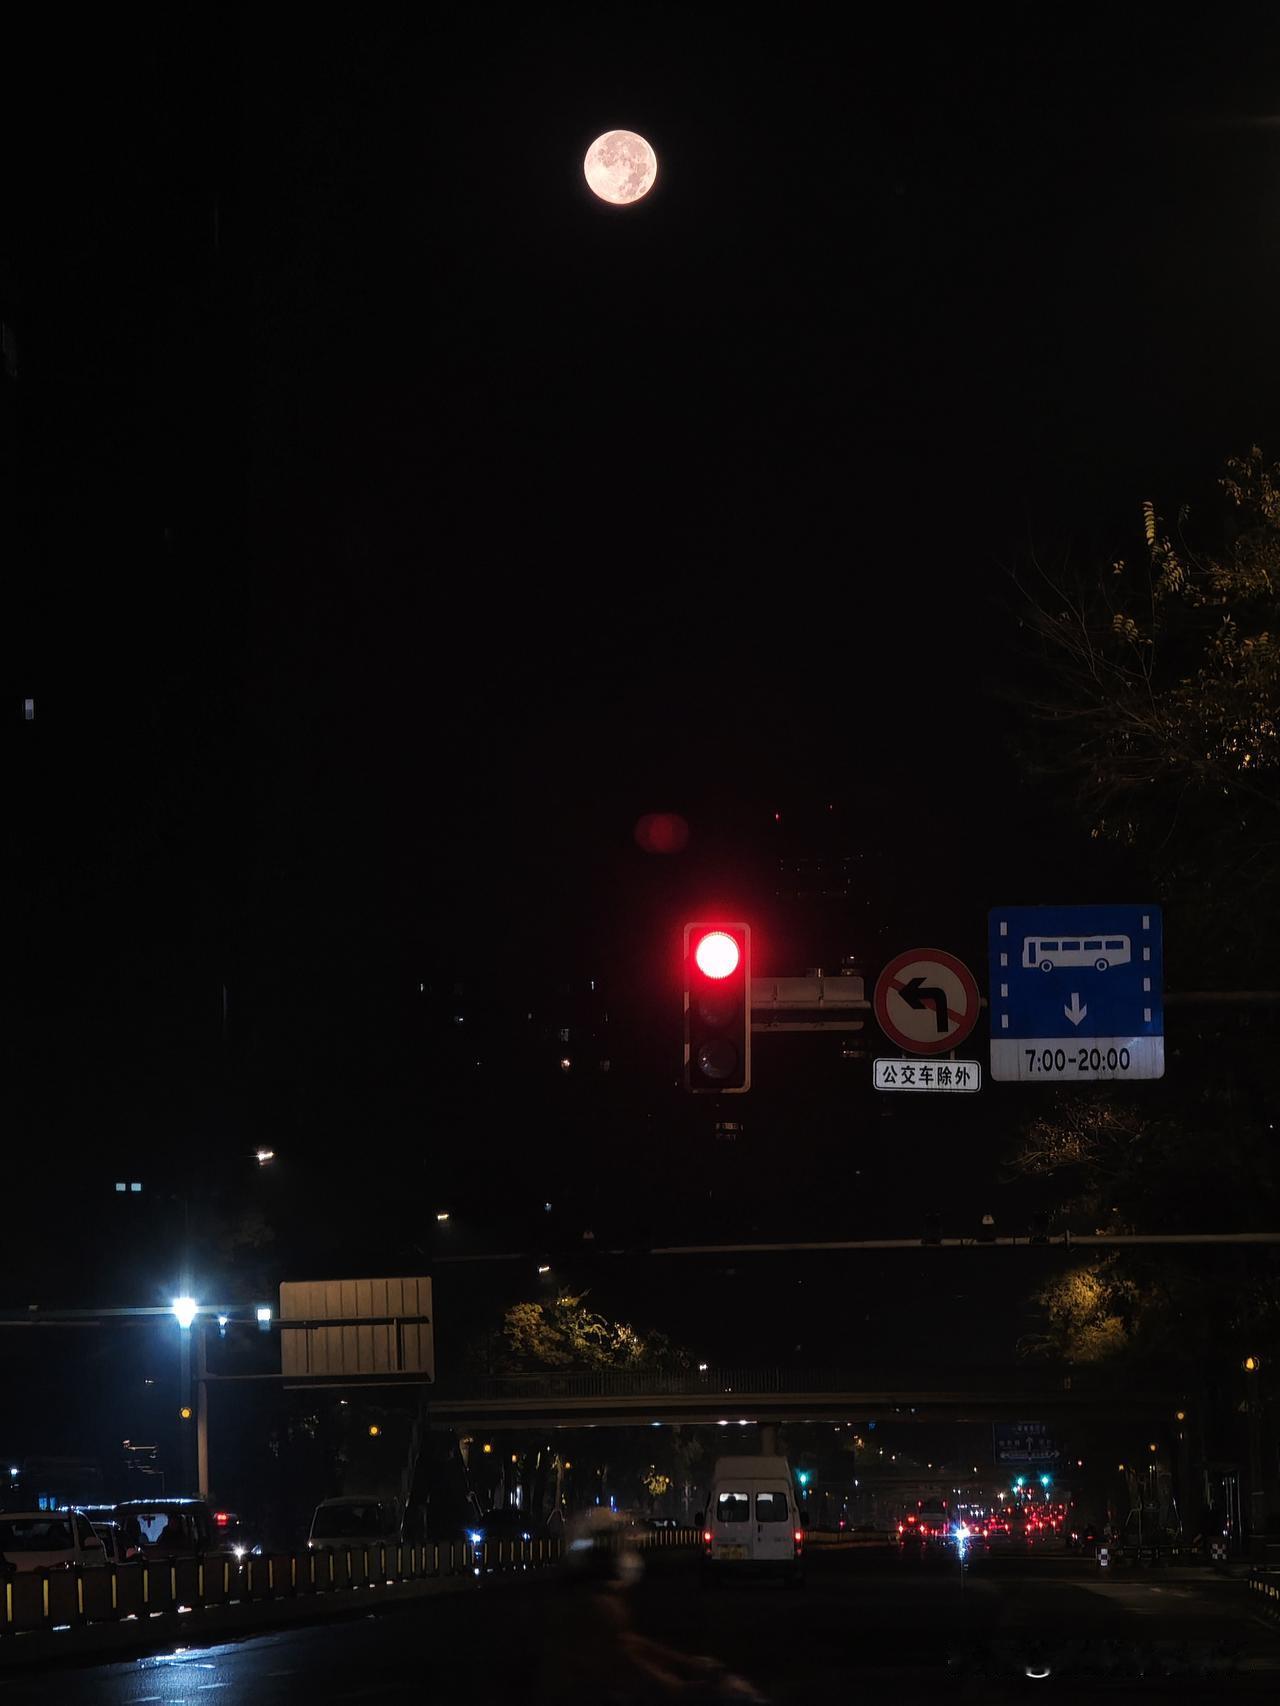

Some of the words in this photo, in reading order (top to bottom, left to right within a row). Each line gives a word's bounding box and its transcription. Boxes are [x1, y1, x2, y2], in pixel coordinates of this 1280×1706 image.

[1025, 1048, 1130, 1072] 7:00-20:00
[882, 1065, 971, 1086] 公交车除外
